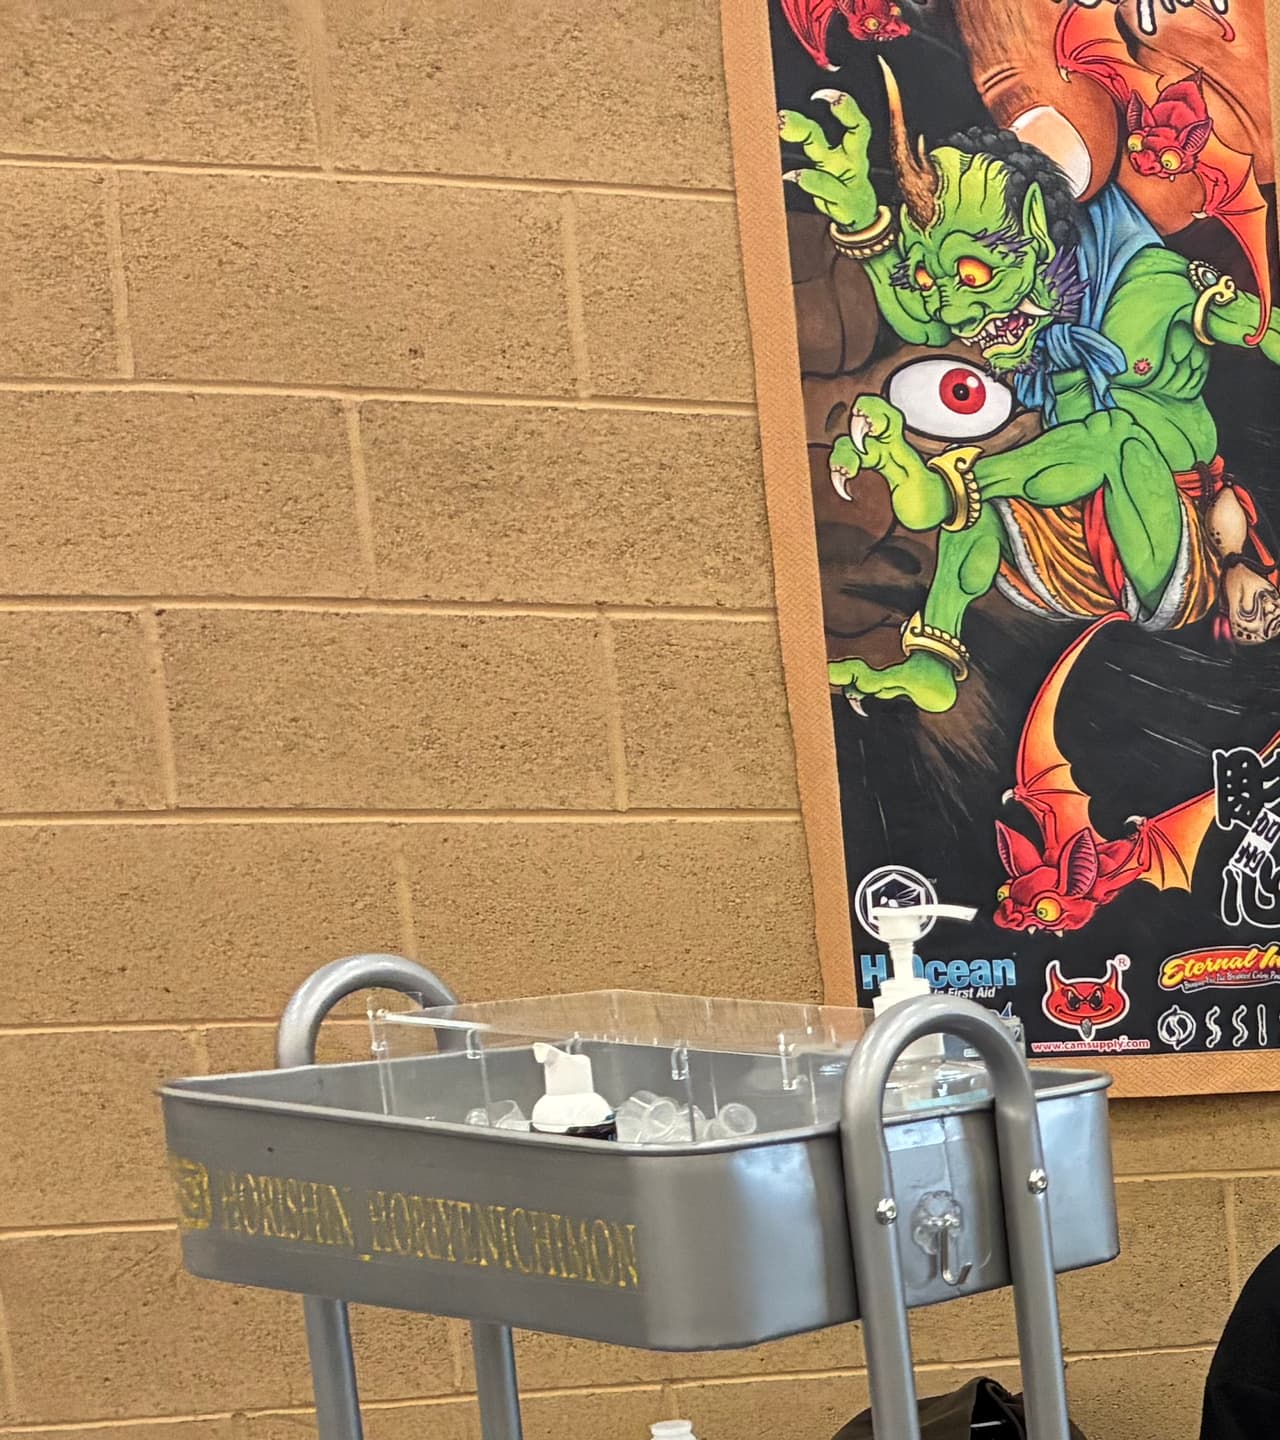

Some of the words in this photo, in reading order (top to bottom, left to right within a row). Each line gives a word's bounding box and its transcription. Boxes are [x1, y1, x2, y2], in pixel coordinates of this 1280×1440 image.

[1162, 948, 1259, 986] Eternal
[976, 986, 996, 998] Aid
[1032, 1038, 1150, 1051] www.camsupply.com
